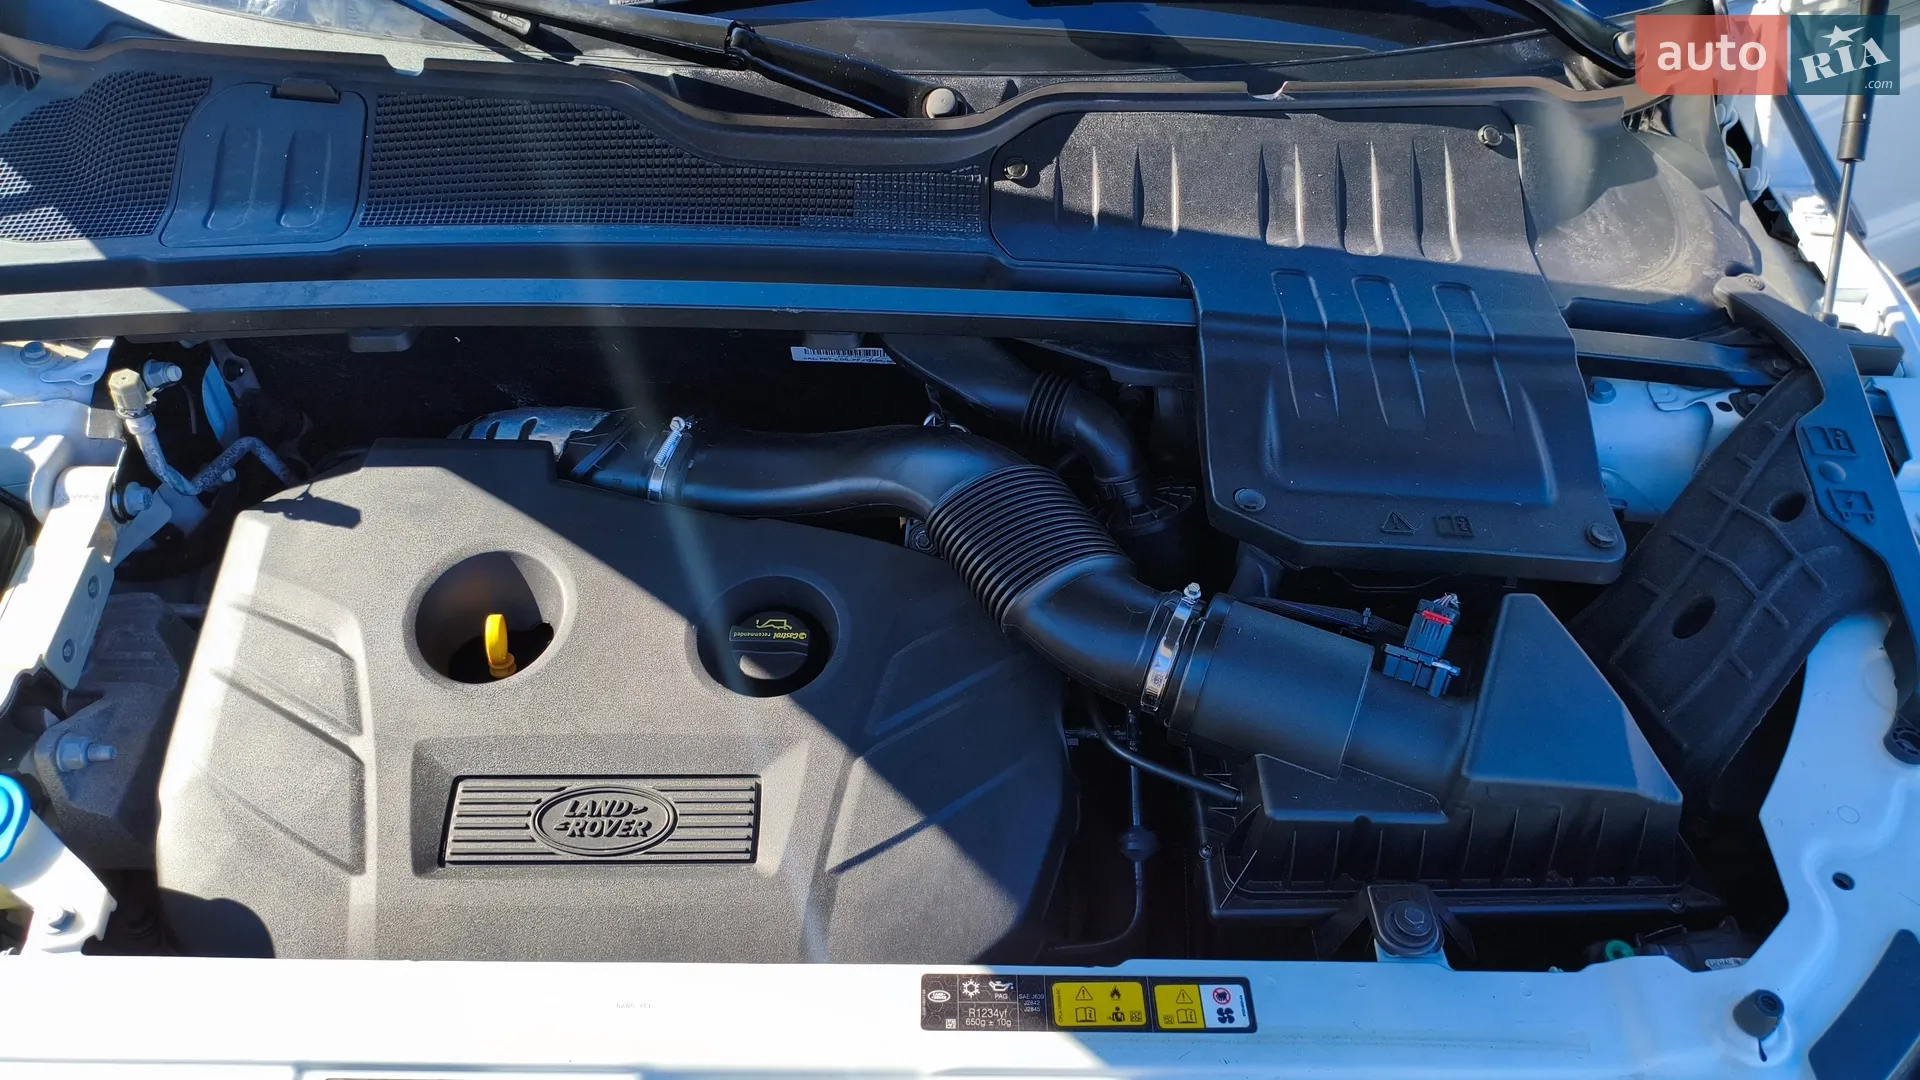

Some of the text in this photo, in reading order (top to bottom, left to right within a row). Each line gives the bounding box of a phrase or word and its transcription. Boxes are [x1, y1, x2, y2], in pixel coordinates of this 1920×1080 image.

[773, 632, 799, 640] Castrol
[564, 800, 635, 818] LAND
[565, 818, 653, 837] ROVER
[968, 1008, 1008, 1019] R1234yf
[965, 1018, 986, 1027] 650g
[997, 1018, 1012, 1027] 10g
